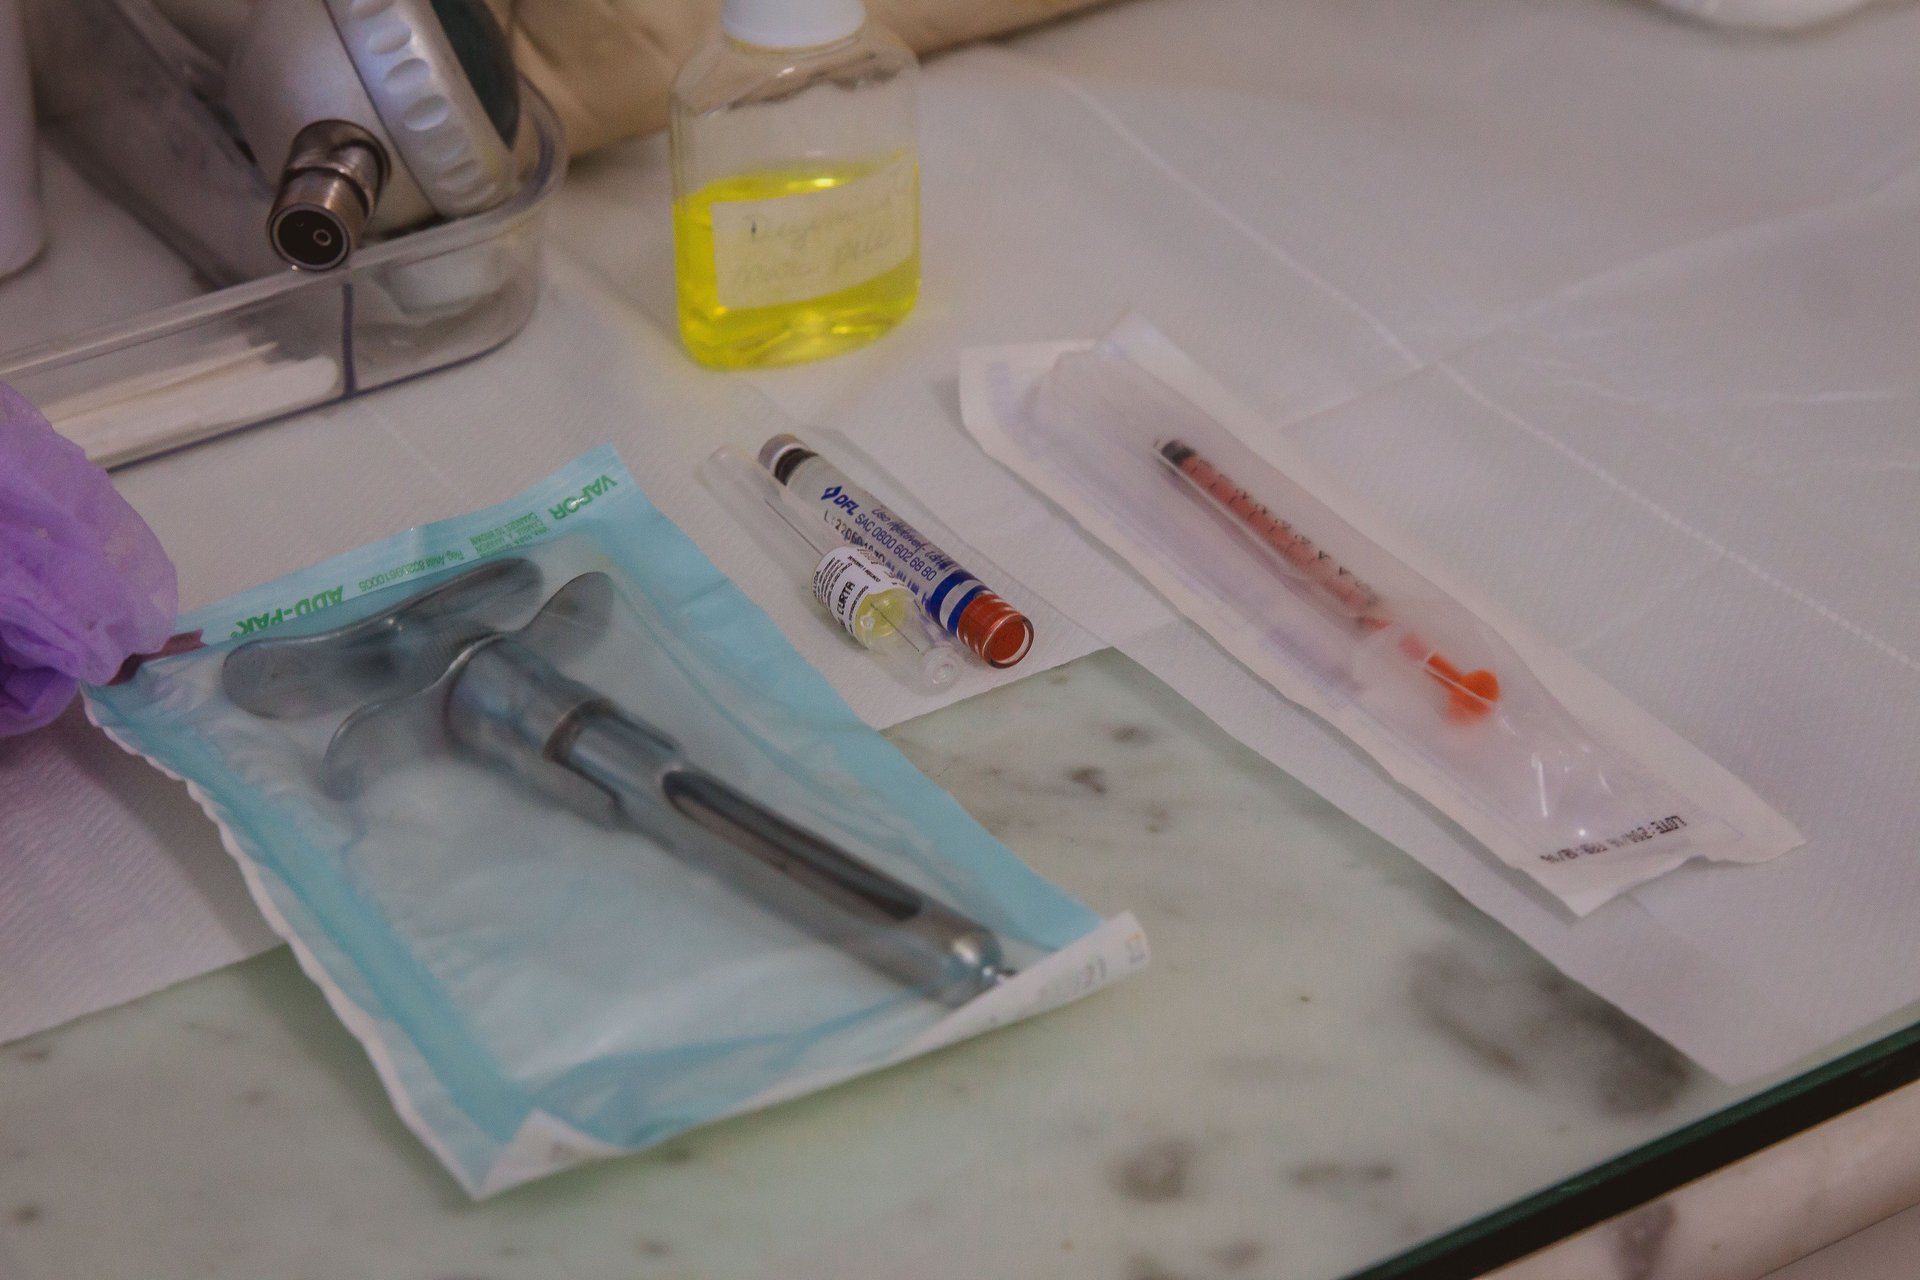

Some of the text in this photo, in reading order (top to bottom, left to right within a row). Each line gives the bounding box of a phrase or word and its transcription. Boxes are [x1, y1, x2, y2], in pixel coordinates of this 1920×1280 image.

[548, 474, 618, 520] VAPOR
[833, 494, 859, 516] DFL
[855, 513, 875, 532] SAC
[871, 526, 897, 549] 0800
[893, 544, 913, 563] 602
[909, 556, 924, 572] 68
[921, 567, 937, 582] 80
[235, 585, 344, 636] ADD-PAK
[836, 581, 856, 616] CURTA
